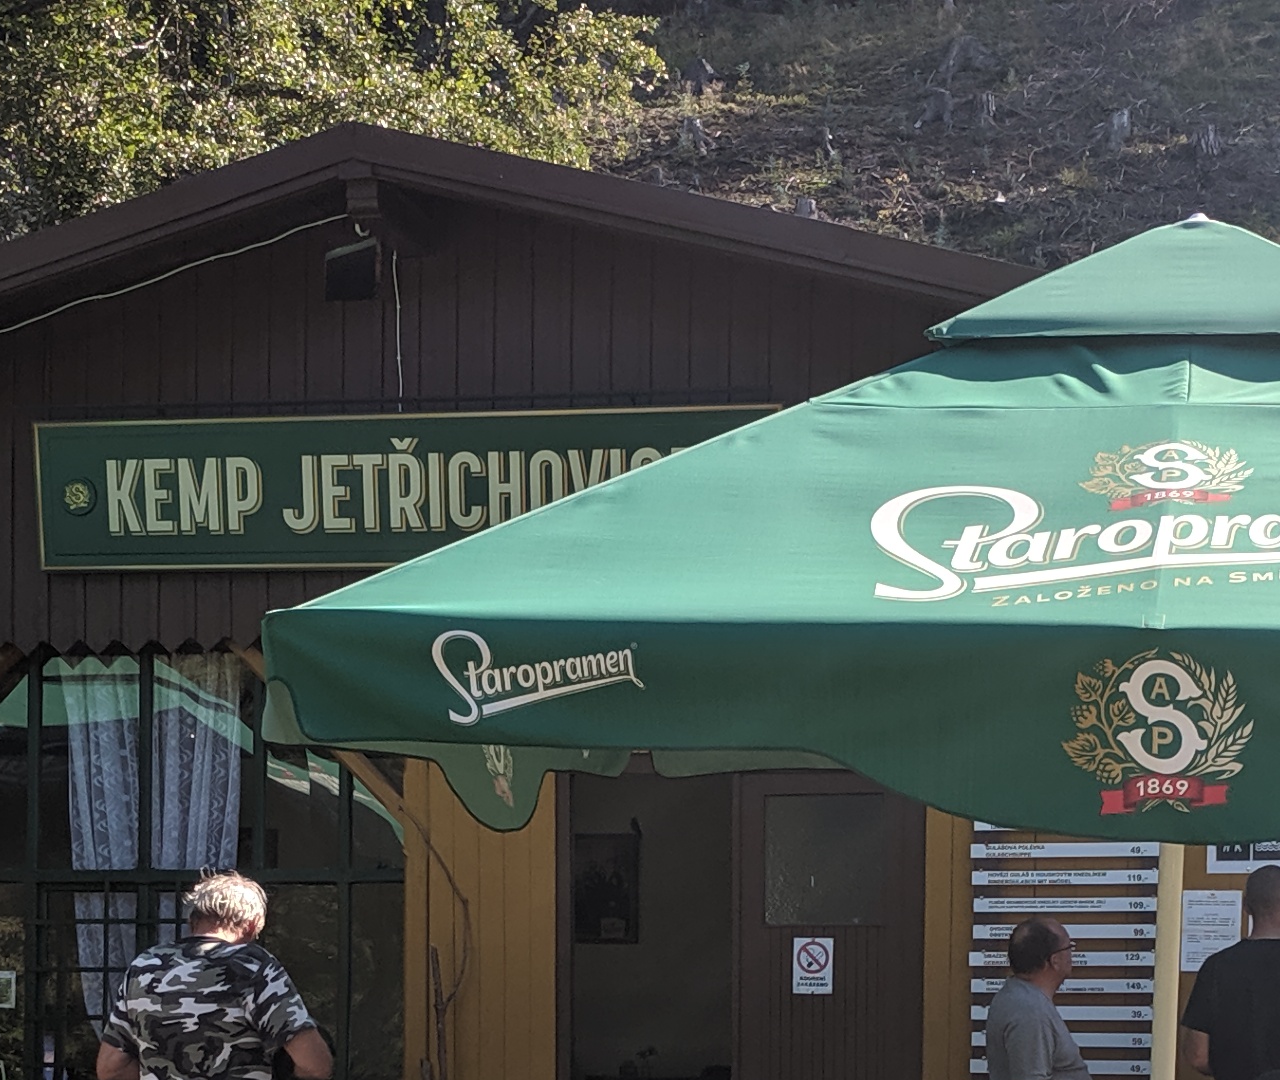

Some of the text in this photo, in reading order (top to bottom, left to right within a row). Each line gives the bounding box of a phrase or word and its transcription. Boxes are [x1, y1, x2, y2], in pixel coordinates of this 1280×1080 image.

[105, 437, 686, 536] KEMP JETŘICHOV
[1143, 489, 1195, 502] 1869
[991, 579, 1158, 608] ZALOŽENO
[1173, 576, 1214, 588] NA
[432, 630, 645, 726] Staropramen
[1135, 778, 1188, 797] 1869
